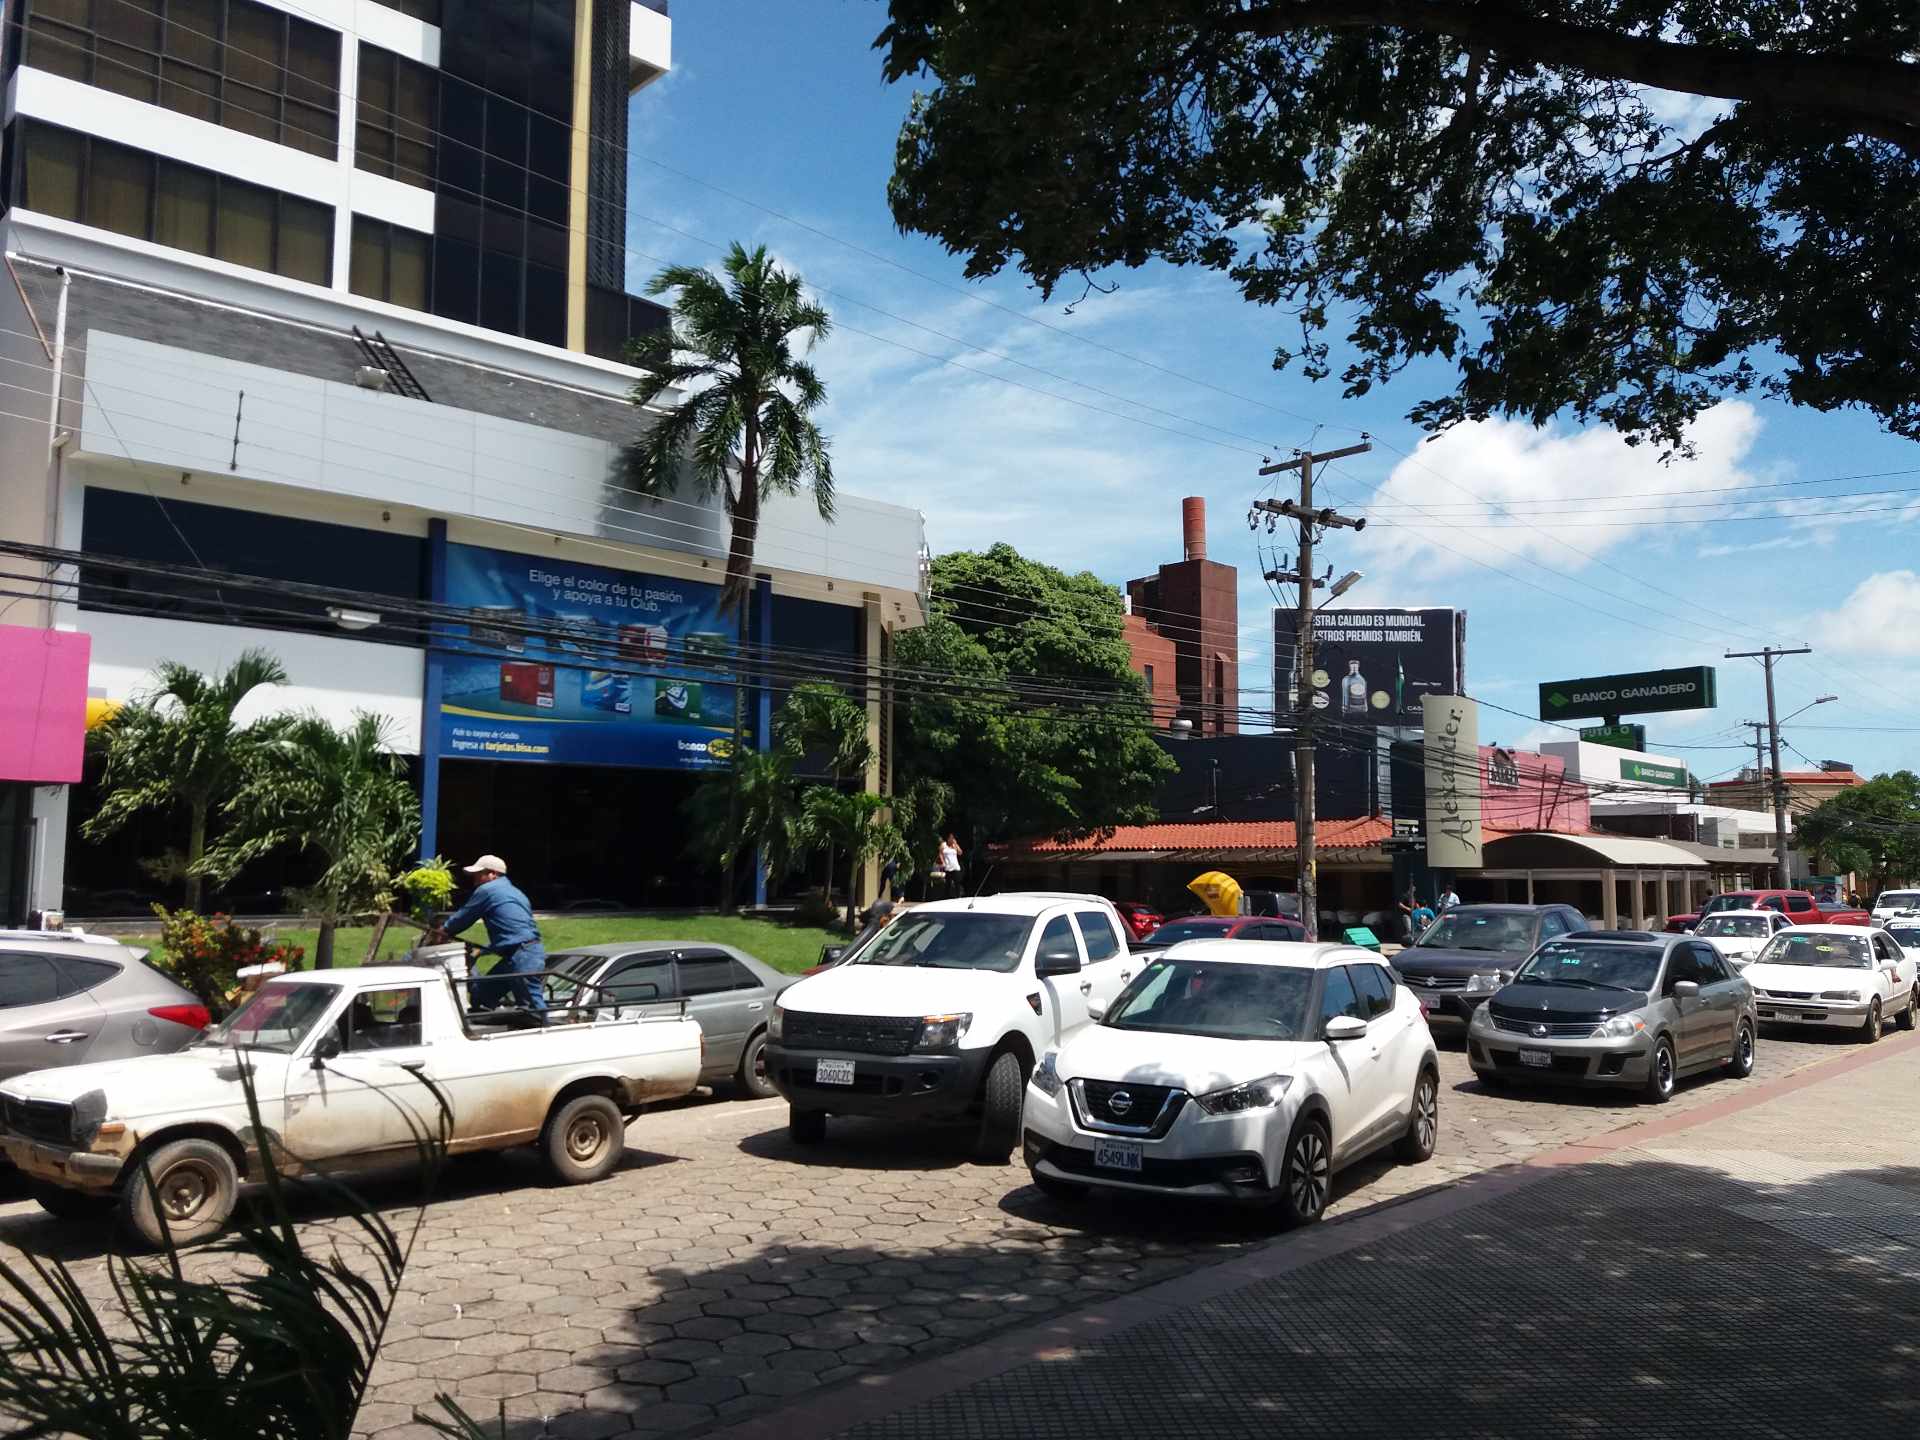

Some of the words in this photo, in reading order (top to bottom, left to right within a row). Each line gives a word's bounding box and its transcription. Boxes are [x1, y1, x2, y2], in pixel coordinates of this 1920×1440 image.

[528, 569, 561, 587] Elige
[563, 575, 574, 587] el
[577, 578, 609, 592] color
[611, 583, 627, 595] de
[630, 586, 642, 597] tu
[644, 588, 683, 603] pasión
[552, 589, 561, 600] y
[564, 590, 602, 605] apoya
[605, 596, 613, 605] a
[615, 595, 627, 607] tu
[630, 598, 661, 612] Club.
[1337, 615, 1373, 627] CALIDAD
[1373, 615, 1385, 627] ES
[1385, 615, 1425, 627] MUNDIAL.
[1346, 630, 1383, 641] PREMIOS
[1384, 628, 1424, 642] TAMBIÉN.
[1572, 690, 1617, 703] BANCO
[1621, 682, 1696, 698] GANADERO
[677, 740, 707, 751] banco
